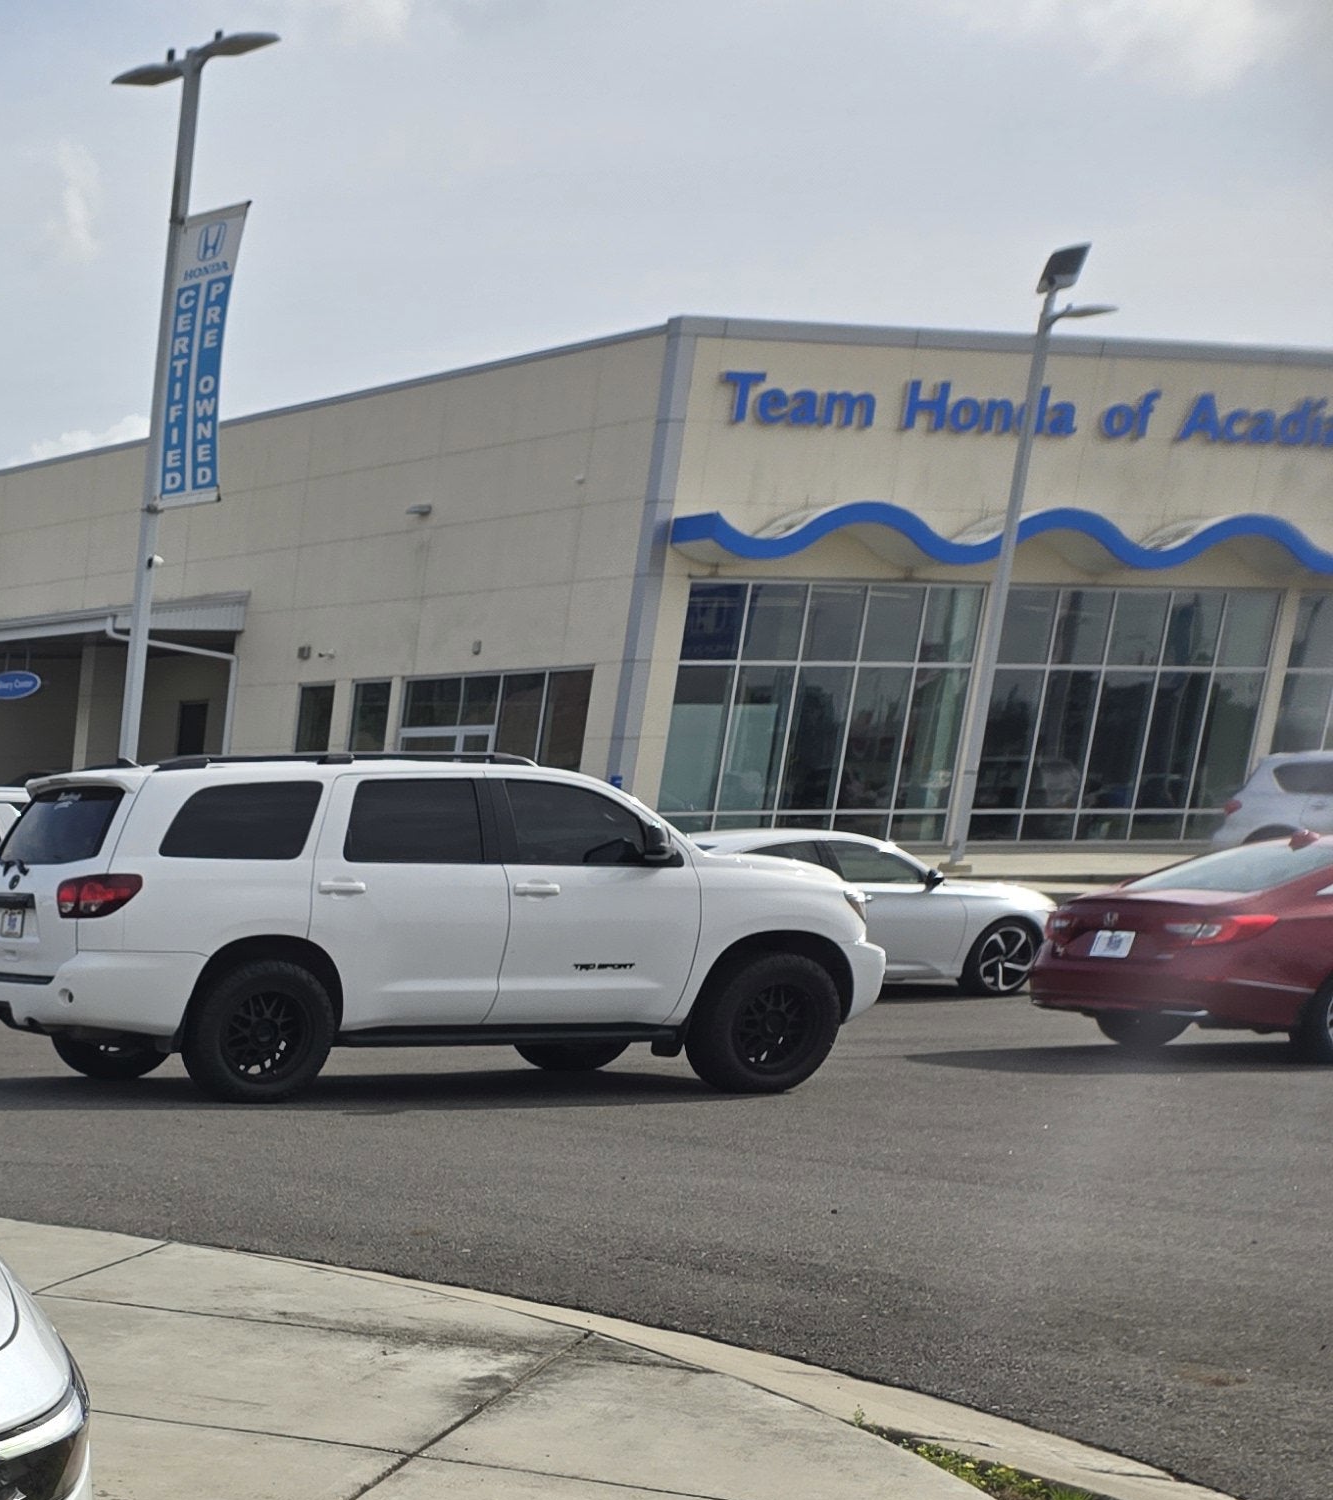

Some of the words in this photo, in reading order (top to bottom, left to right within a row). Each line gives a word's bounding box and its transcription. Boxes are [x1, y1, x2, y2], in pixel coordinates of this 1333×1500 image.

[184, 261, 229, 280] HONDA
[203, 282, 225, 348] PRE
[164, 290, 196, 490] CERTIFIED
[723, 371, 876, 427] Team
[904, 380, 1077, 437] Honda
[1104, 390, 1162, 439] of
[196, 375, 215, 485] OWNED
